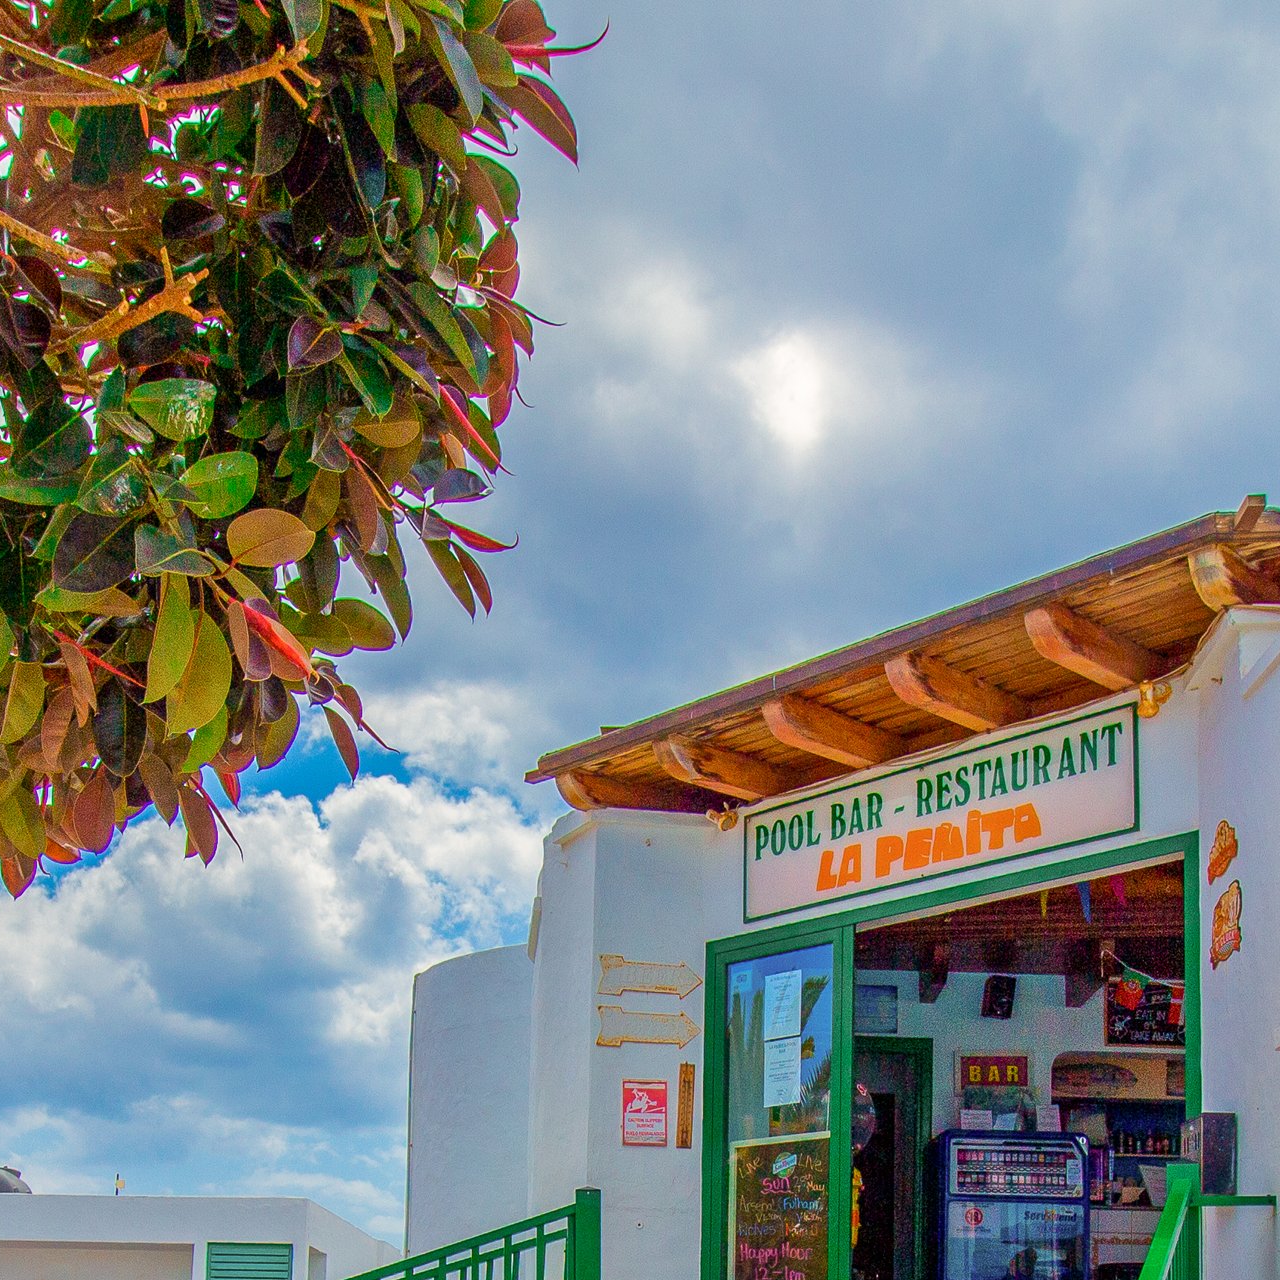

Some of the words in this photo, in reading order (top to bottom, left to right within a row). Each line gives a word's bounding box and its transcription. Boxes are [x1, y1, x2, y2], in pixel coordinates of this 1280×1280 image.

[754, 819, 821, 861] POOL
[830, 792, 883, 840] BAR
[916, 722, 1123, 818] RESTAURANT
[816, 843, 862, 891] LA
[969, 1065, 1019, 1082] BAR
[740, 1243, 778, 1268] Happy
[781, 1242, 814, 1260] Hour
